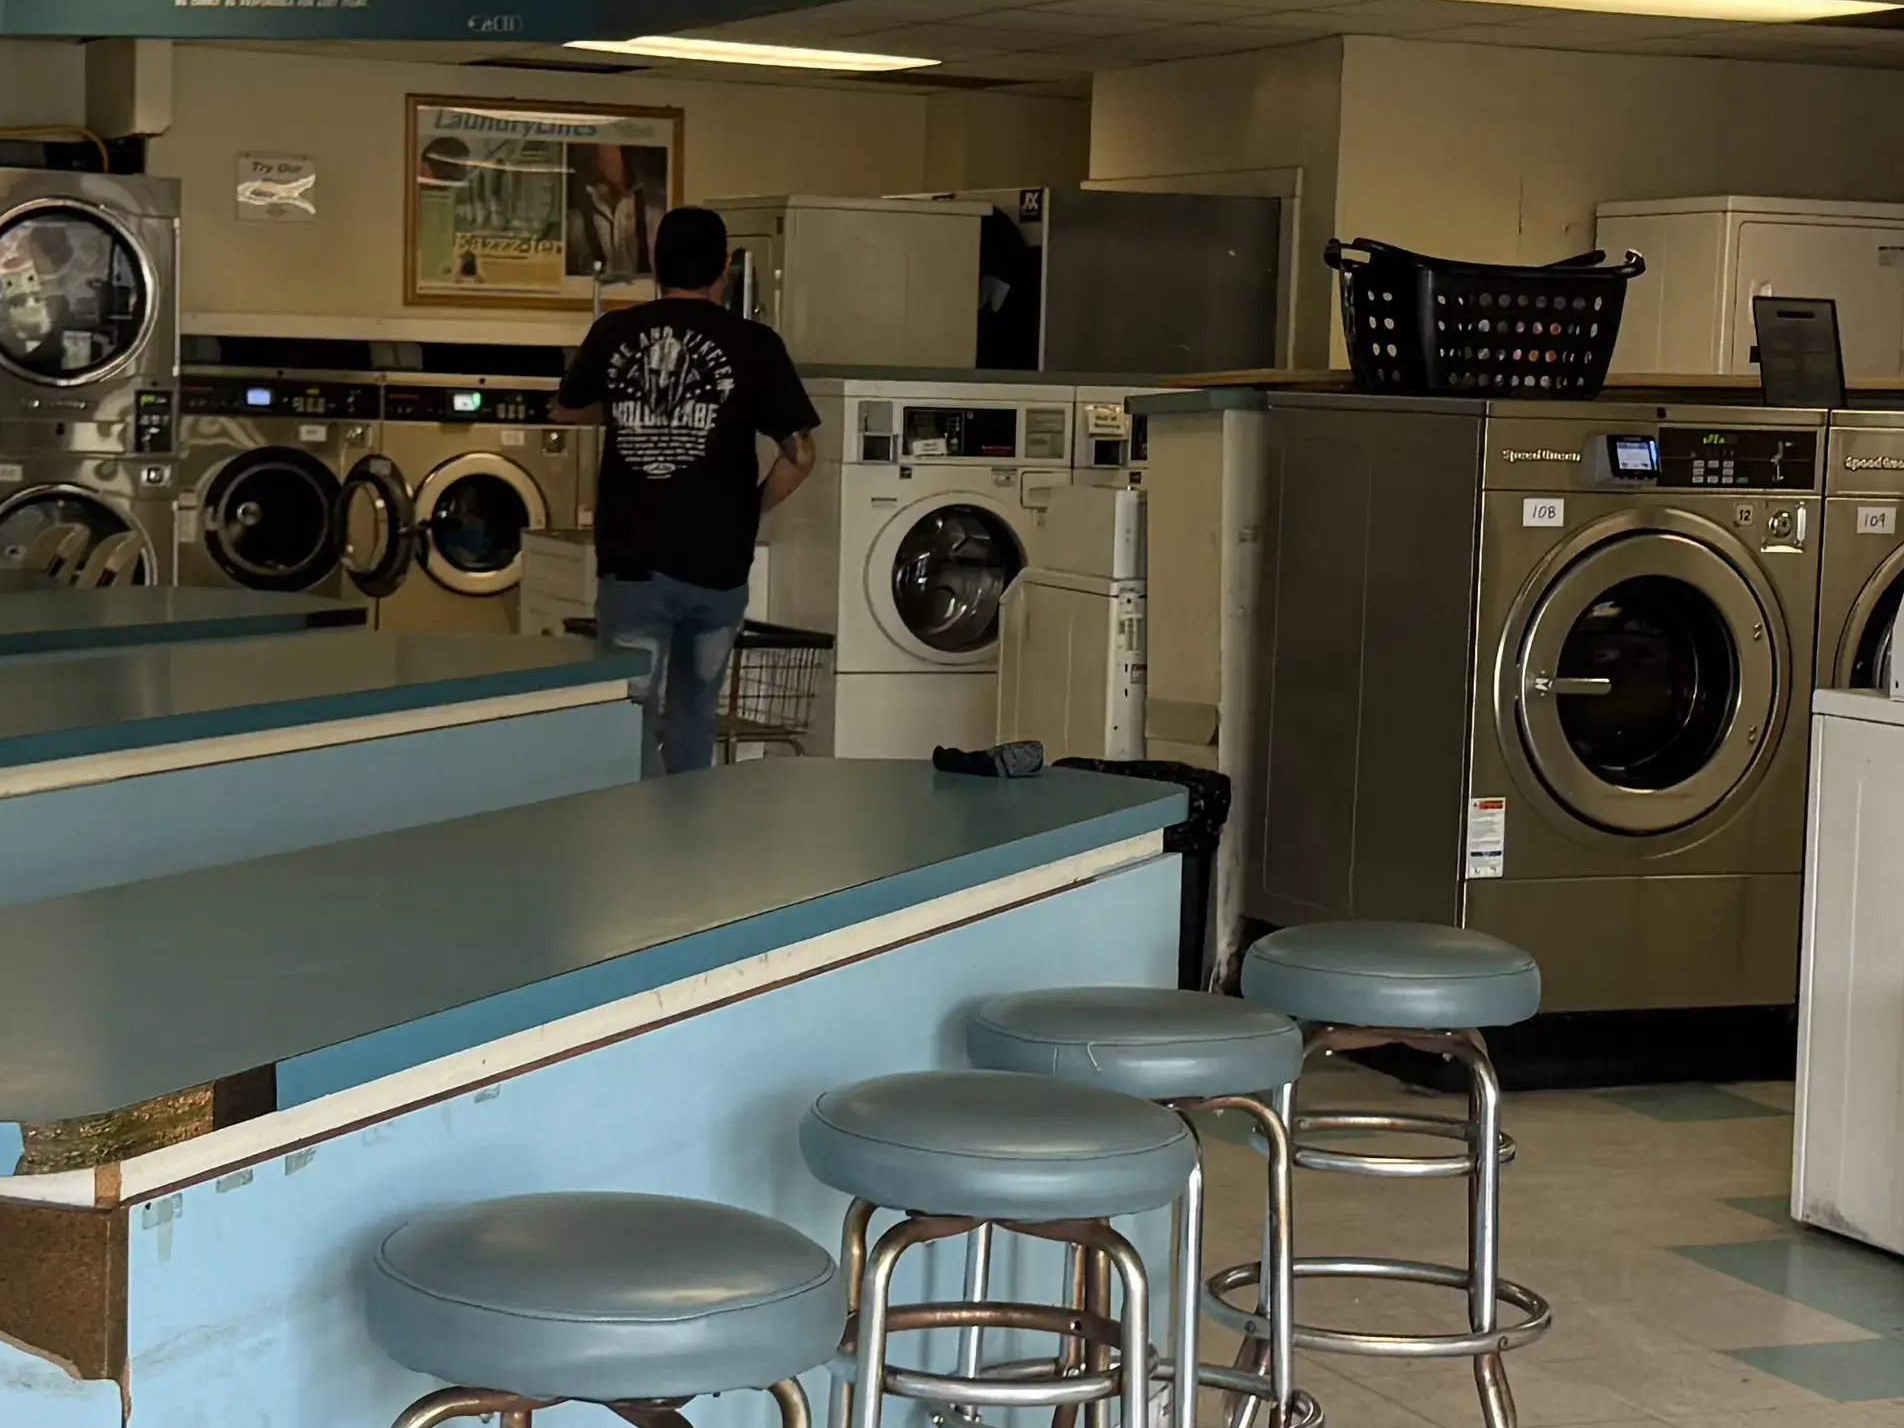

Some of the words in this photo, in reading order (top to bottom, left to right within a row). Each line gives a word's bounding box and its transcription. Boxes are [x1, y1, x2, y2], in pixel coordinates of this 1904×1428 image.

[252, 161, 274, 176] Try
[1739, 509, 1751, 521] 12
[1864, 512, 1887, 528] 109
